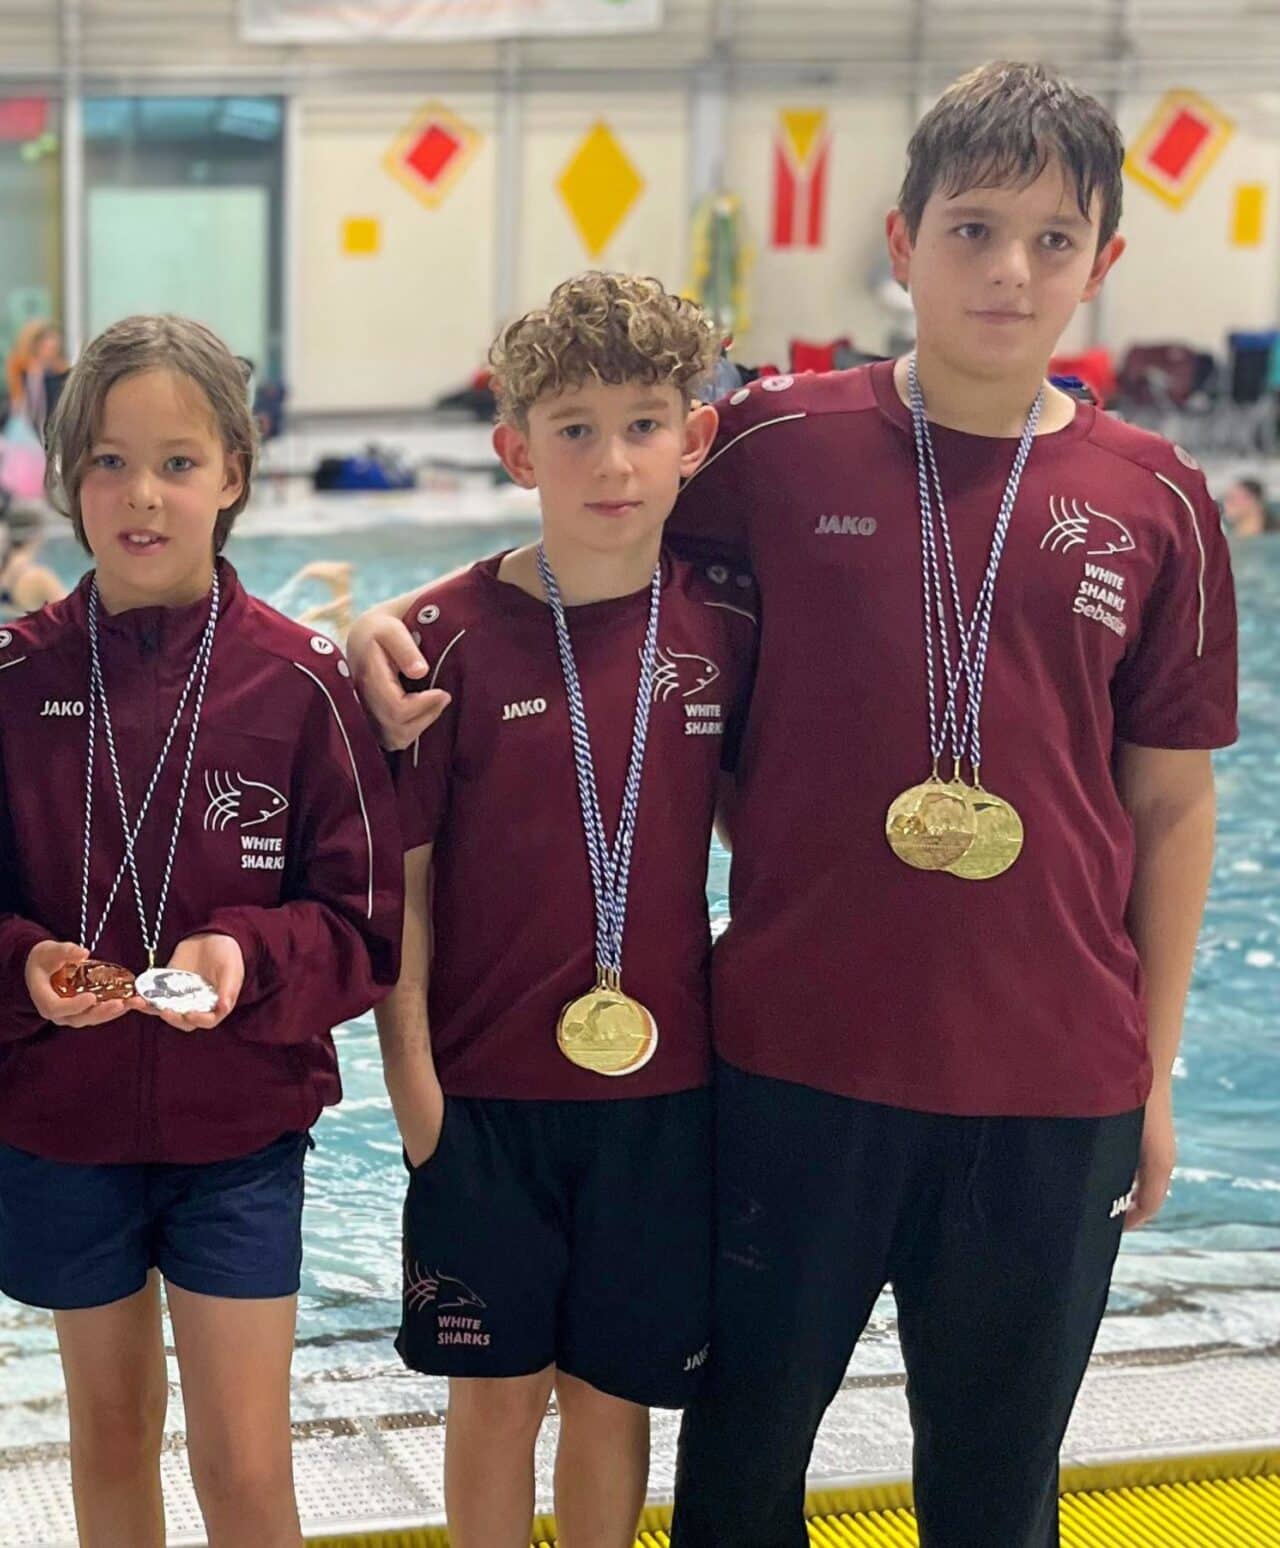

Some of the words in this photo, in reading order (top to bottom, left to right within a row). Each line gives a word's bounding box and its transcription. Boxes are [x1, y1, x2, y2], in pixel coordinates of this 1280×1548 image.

[815, 514, 877, 537] JAKO
[1084, 562, 1125, 591] WHITE
[39, 700, 85, 717] JAKO
[502, 697, 547, 721] JAKO
[684, 703, 721, 718] WHITE
[684, 720, 724, 736] SHARK
[240, 835, 283, 852] WHITE
[437, 1314, 482, 1331] WHITE
[437, 1331, 491, 1346] SHARKS
